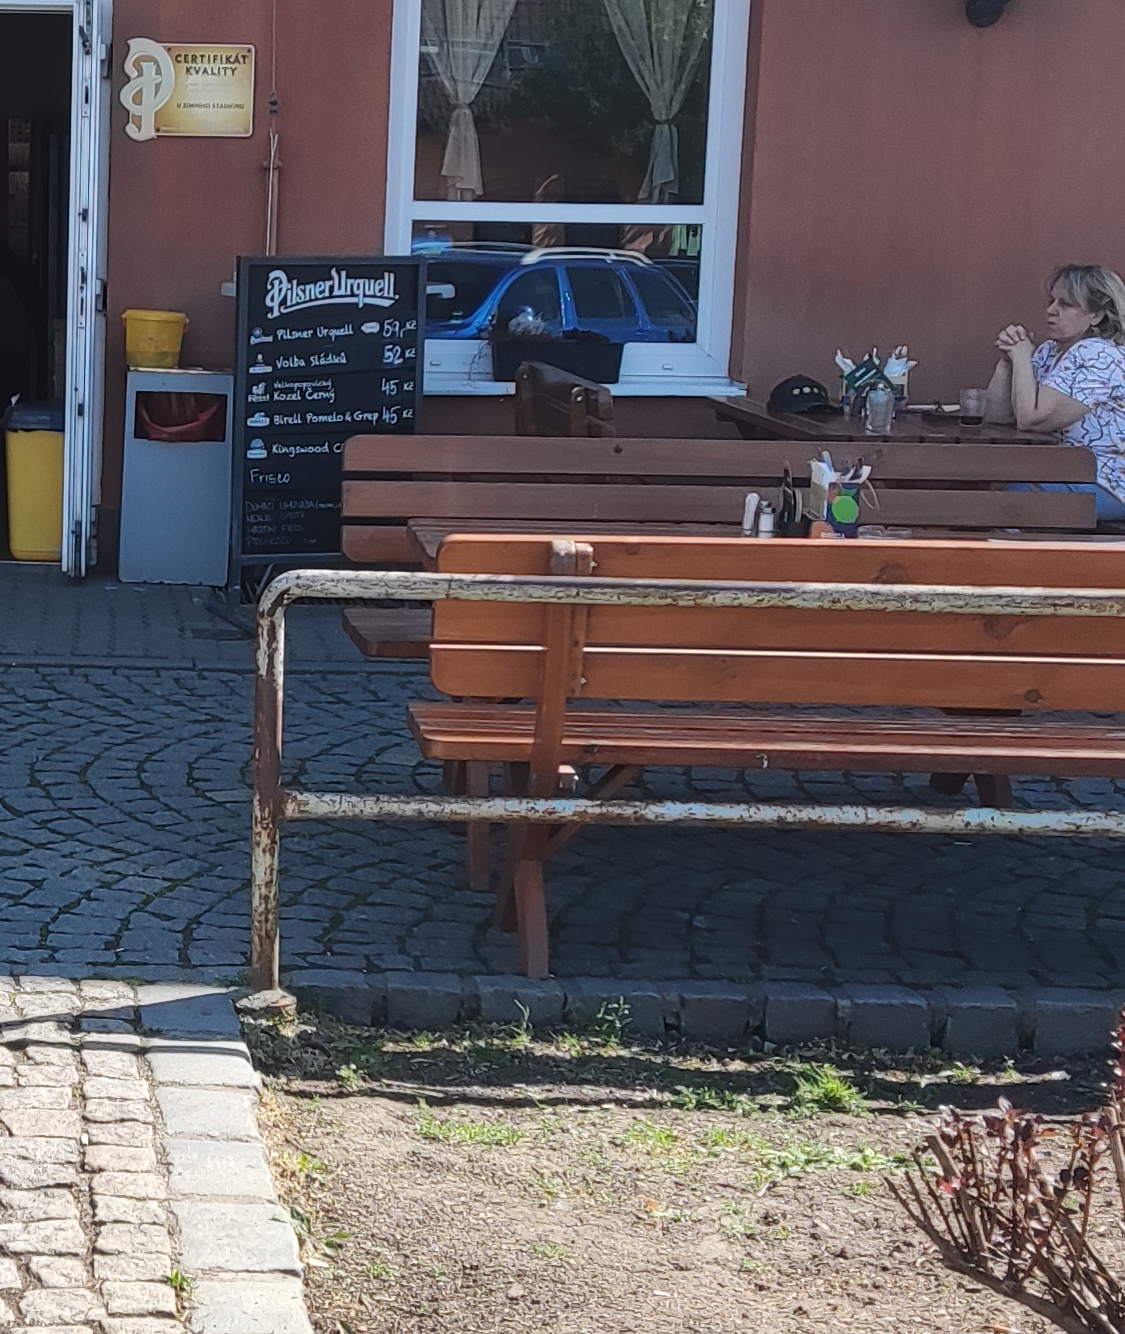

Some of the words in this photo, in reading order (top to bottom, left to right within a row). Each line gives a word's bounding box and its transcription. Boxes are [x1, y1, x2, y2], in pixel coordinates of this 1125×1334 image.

[175, 52, 248, 65] CERTIFIKÁT
[186, 66, 237, 76] KVALITY
[265, 269, 334, 319] Pilsner
[276, 328, 313, 340] Pilsner
[316, 324, 354, 342] Urquell
[310, 352, 347, 366] Sládků
[383, 345, 403, 364] 52
[405, 348, 416, 358] Kč
[273, 390, 301, 402] Kozel
[305, 387, 335, 403] Černý
[381, 378, 399, 396] 45
[403, 381, 414, 391] Kč
[273, 412, 302, 425] Birell
[306, 411, 343, 424] Pomelo
[345, 411, 352, 422] &
[354, 411, 379, 426] Grep
[382, 406, 401, 424] 45
[272, 441, 329, 457] Kingswood
[250, 468, 290, 484] Frisco
